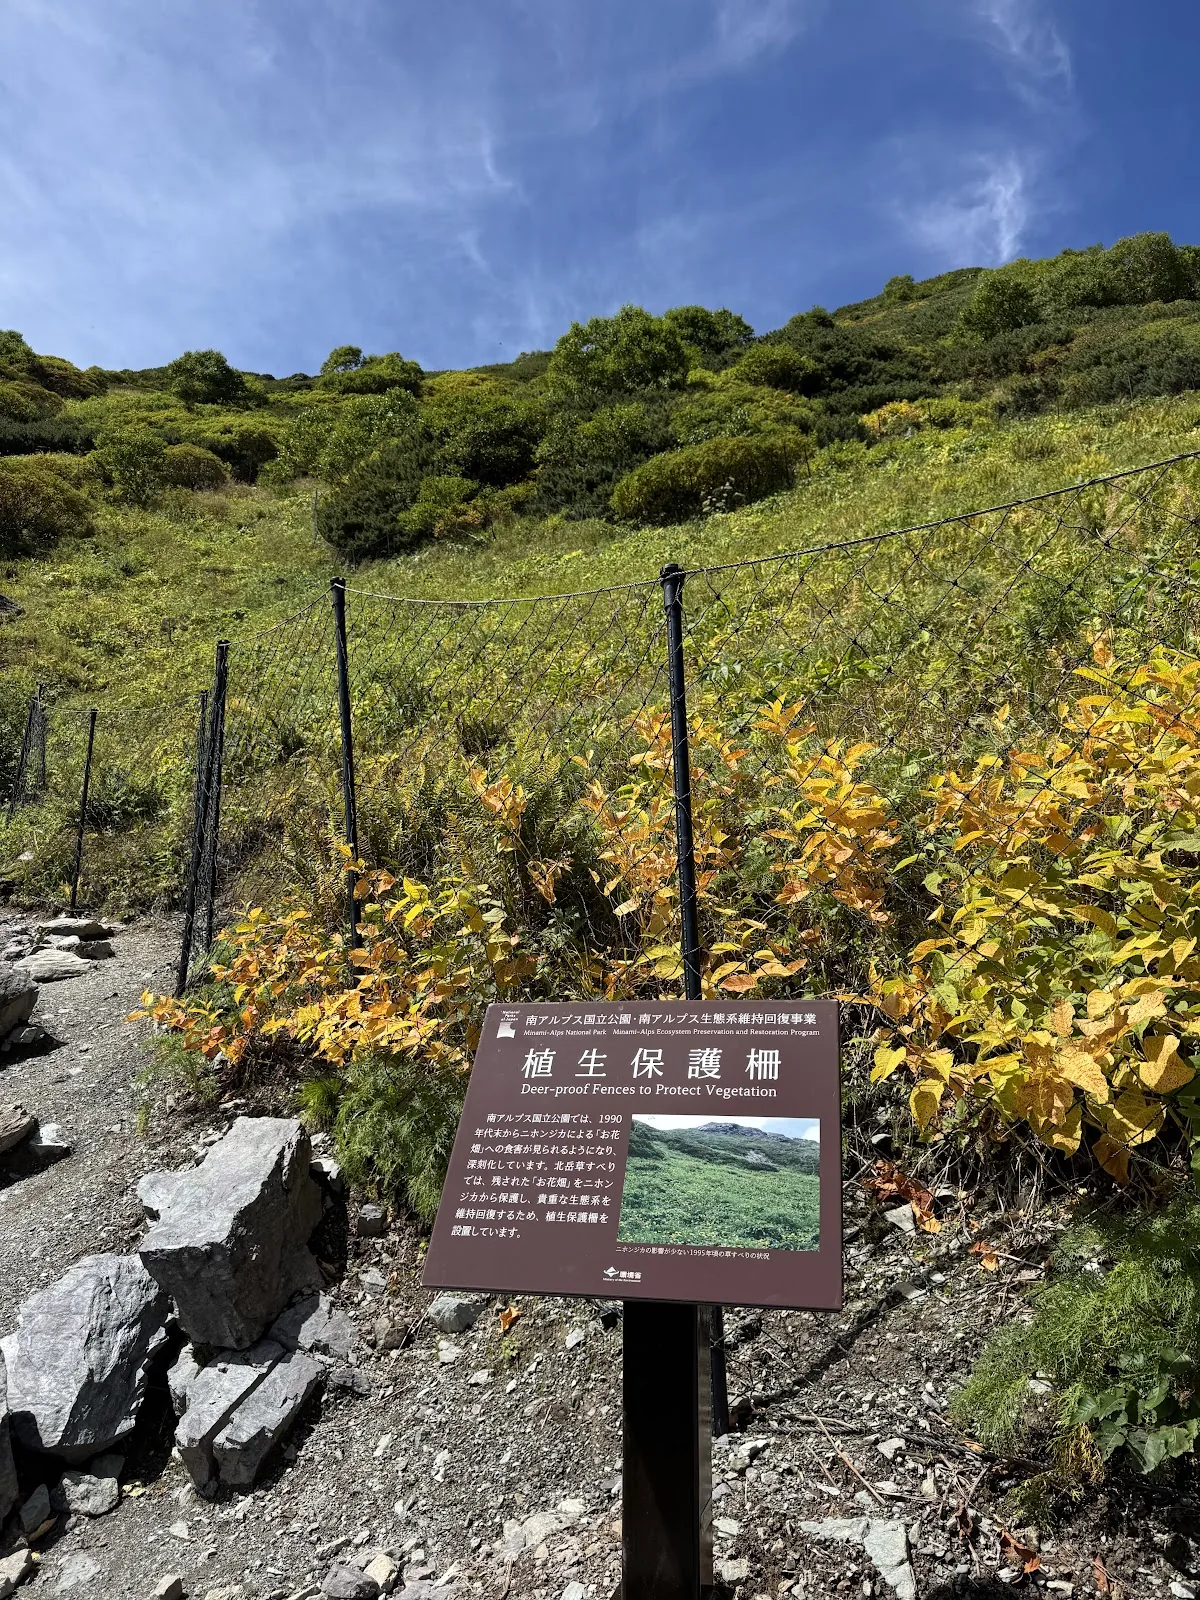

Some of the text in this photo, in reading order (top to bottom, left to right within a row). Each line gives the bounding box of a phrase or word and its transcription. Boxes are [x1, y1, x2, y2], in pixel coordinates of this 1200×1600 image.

[523, 1029, 564, 1037] Minami-Alps
[612, 1028, 655, 1036] Minami-Alps
[656, 1028, 692, 1036] Ecosystem
[693, 1028, 734, 1036] Preservation
[790, 1029, 820, 1037] Program
[521, 1047, 782, 1080] 植生保護柵
[521, 1083, 777, 1099] Deer-proof Fences to Protect Vegetation
